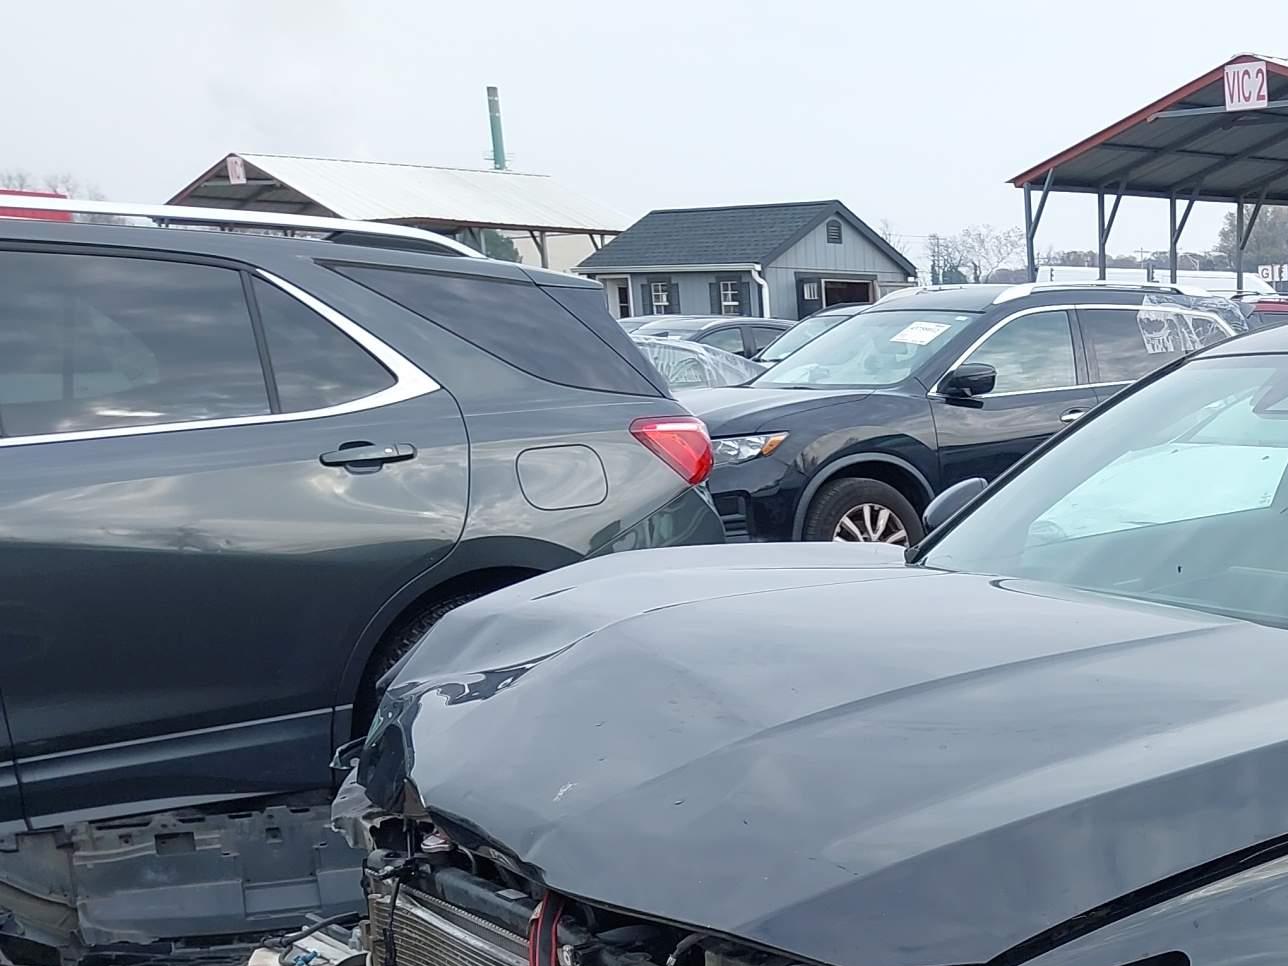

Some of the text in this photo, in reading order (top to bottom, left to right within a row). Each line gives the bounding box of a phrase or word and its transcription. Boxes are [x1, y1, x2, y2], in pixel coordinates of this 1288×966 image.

[1226, 68, 1265, 104] VIC 2
[1261, 268, 1270, 278] G
